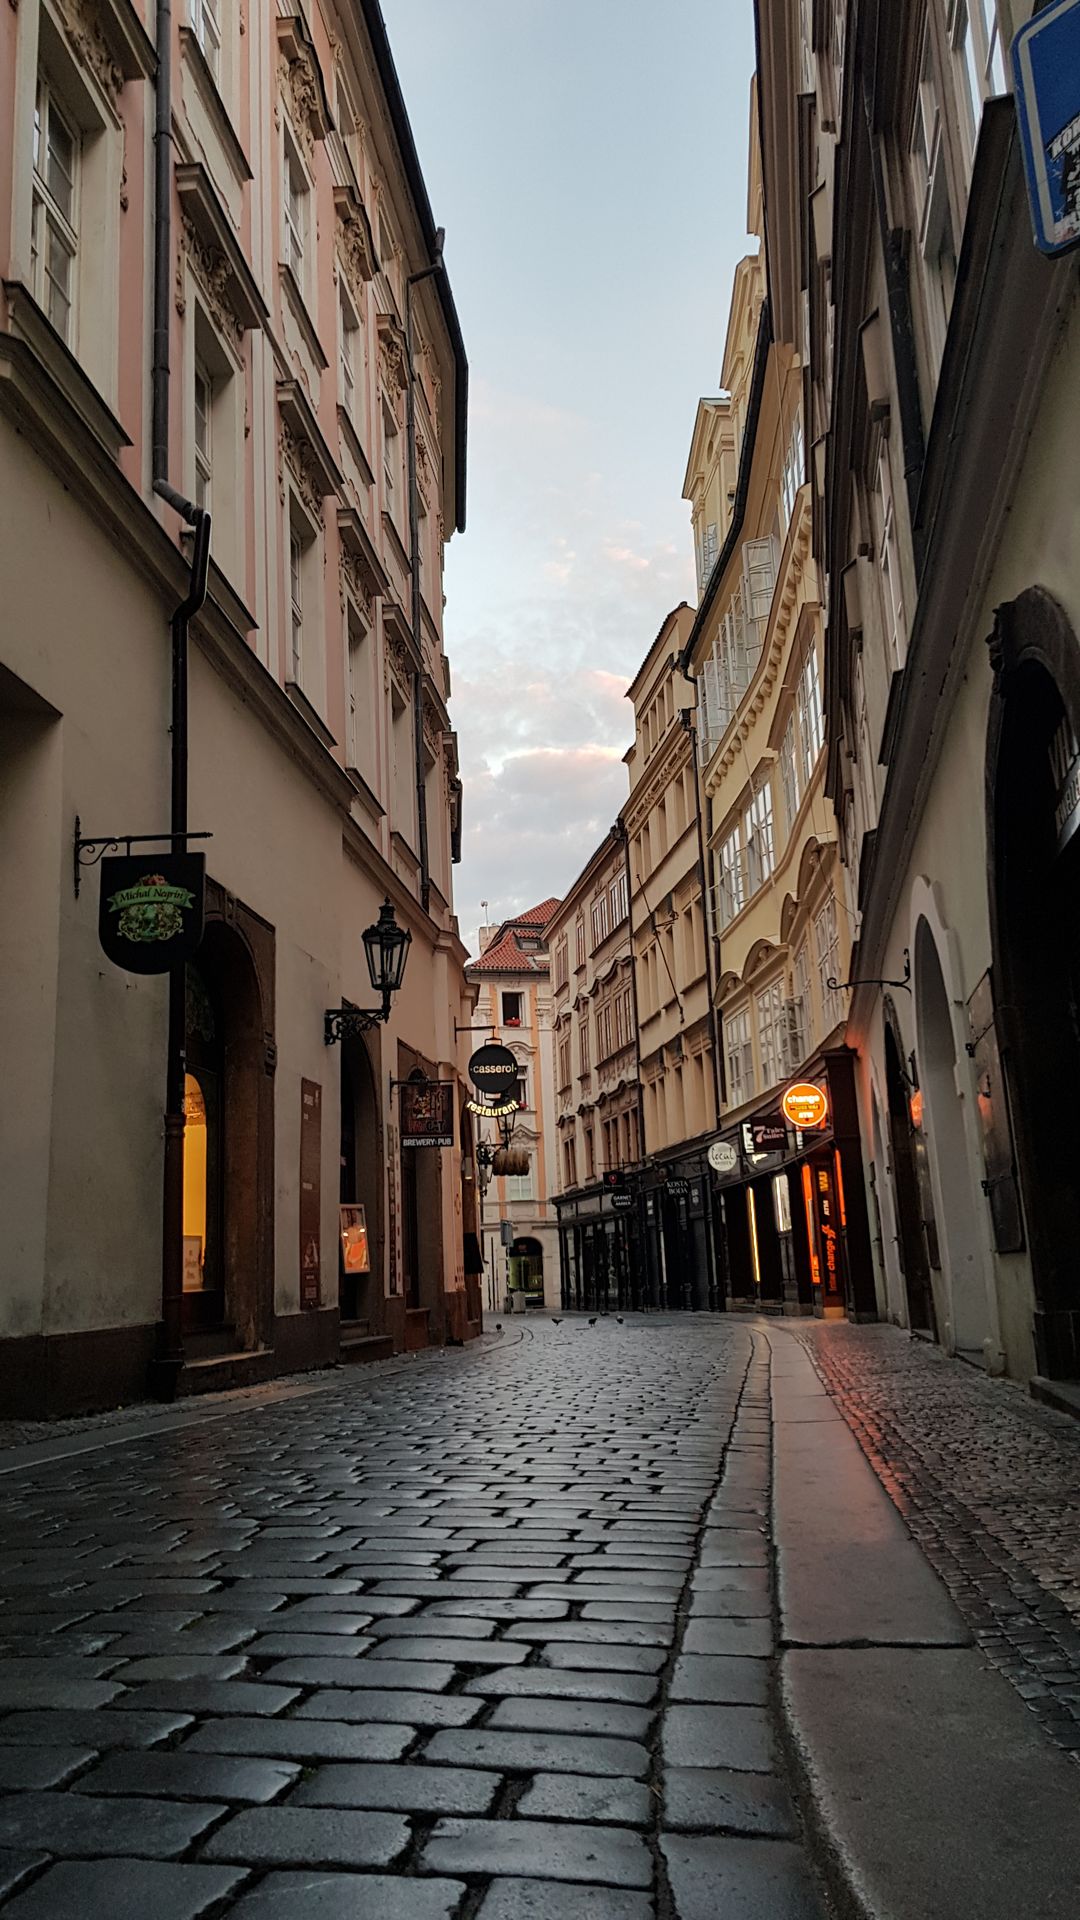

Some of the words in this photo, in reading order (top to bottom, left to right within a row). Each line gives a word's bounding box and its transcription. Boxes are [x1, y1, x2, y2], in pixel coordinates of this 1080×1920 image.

[119, 887, 151, 902] Michal
[473, 1063, 514, 1074] casserol
[787, 1095, 820, 1104] change
[467, 1099, 519, 1117] restaurant
[753, 1126, 766, 1143] 7
[402, 1138, 436, 1147] BREWERY
[437, 1137, 452, 1146] PUB
[711, 1147, 734, 1160] local
[666, 1180, 689, 1188] KOSTA
[825, 1240, 837, 1271] change
